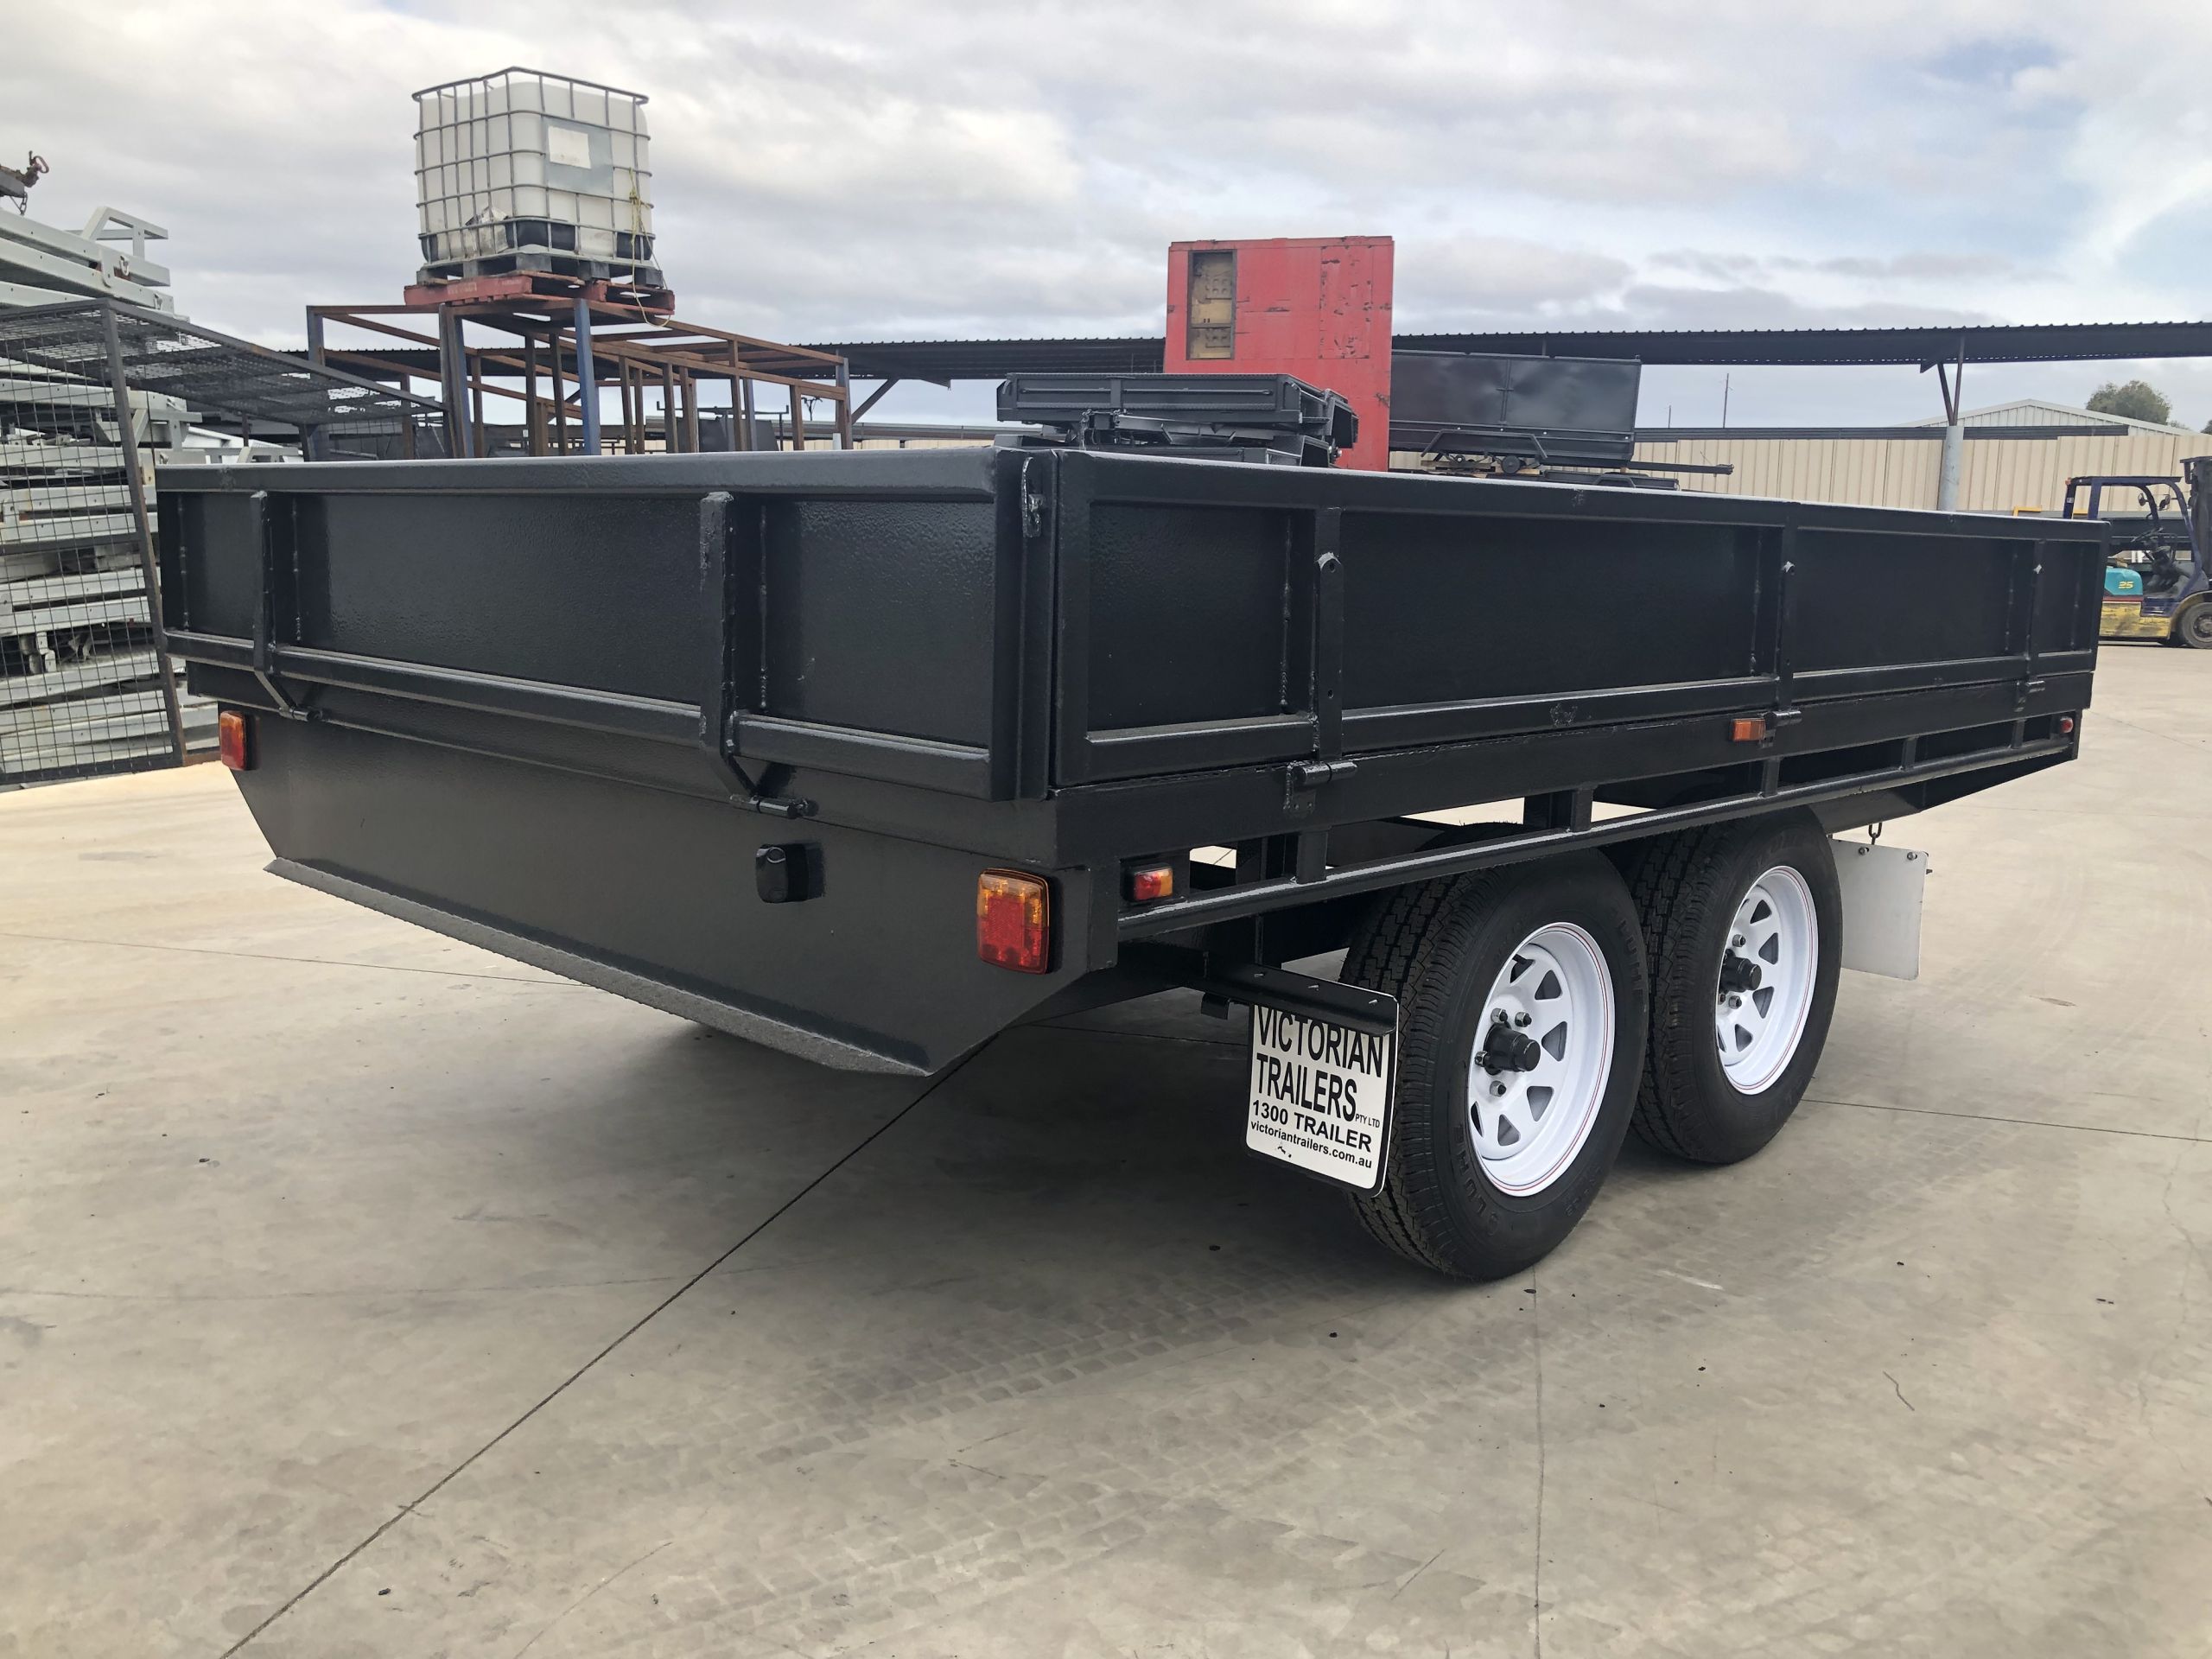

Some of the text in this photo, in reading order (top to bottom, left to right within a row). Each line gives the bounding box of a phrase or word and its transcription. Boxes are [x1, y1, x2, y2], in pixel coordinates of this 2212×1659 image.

[1257, 1006, 1382, 1078] VICTORIAN
[1256, 1052, 1357, 1122] TRAILERS
[1250, 1120, 1372, 1169] victoriantrailers.com.au
[1253, 1099, 1372, 1153] 1300 TRAILER
[1355, 1113, 1381, 1128] PTY LTD
